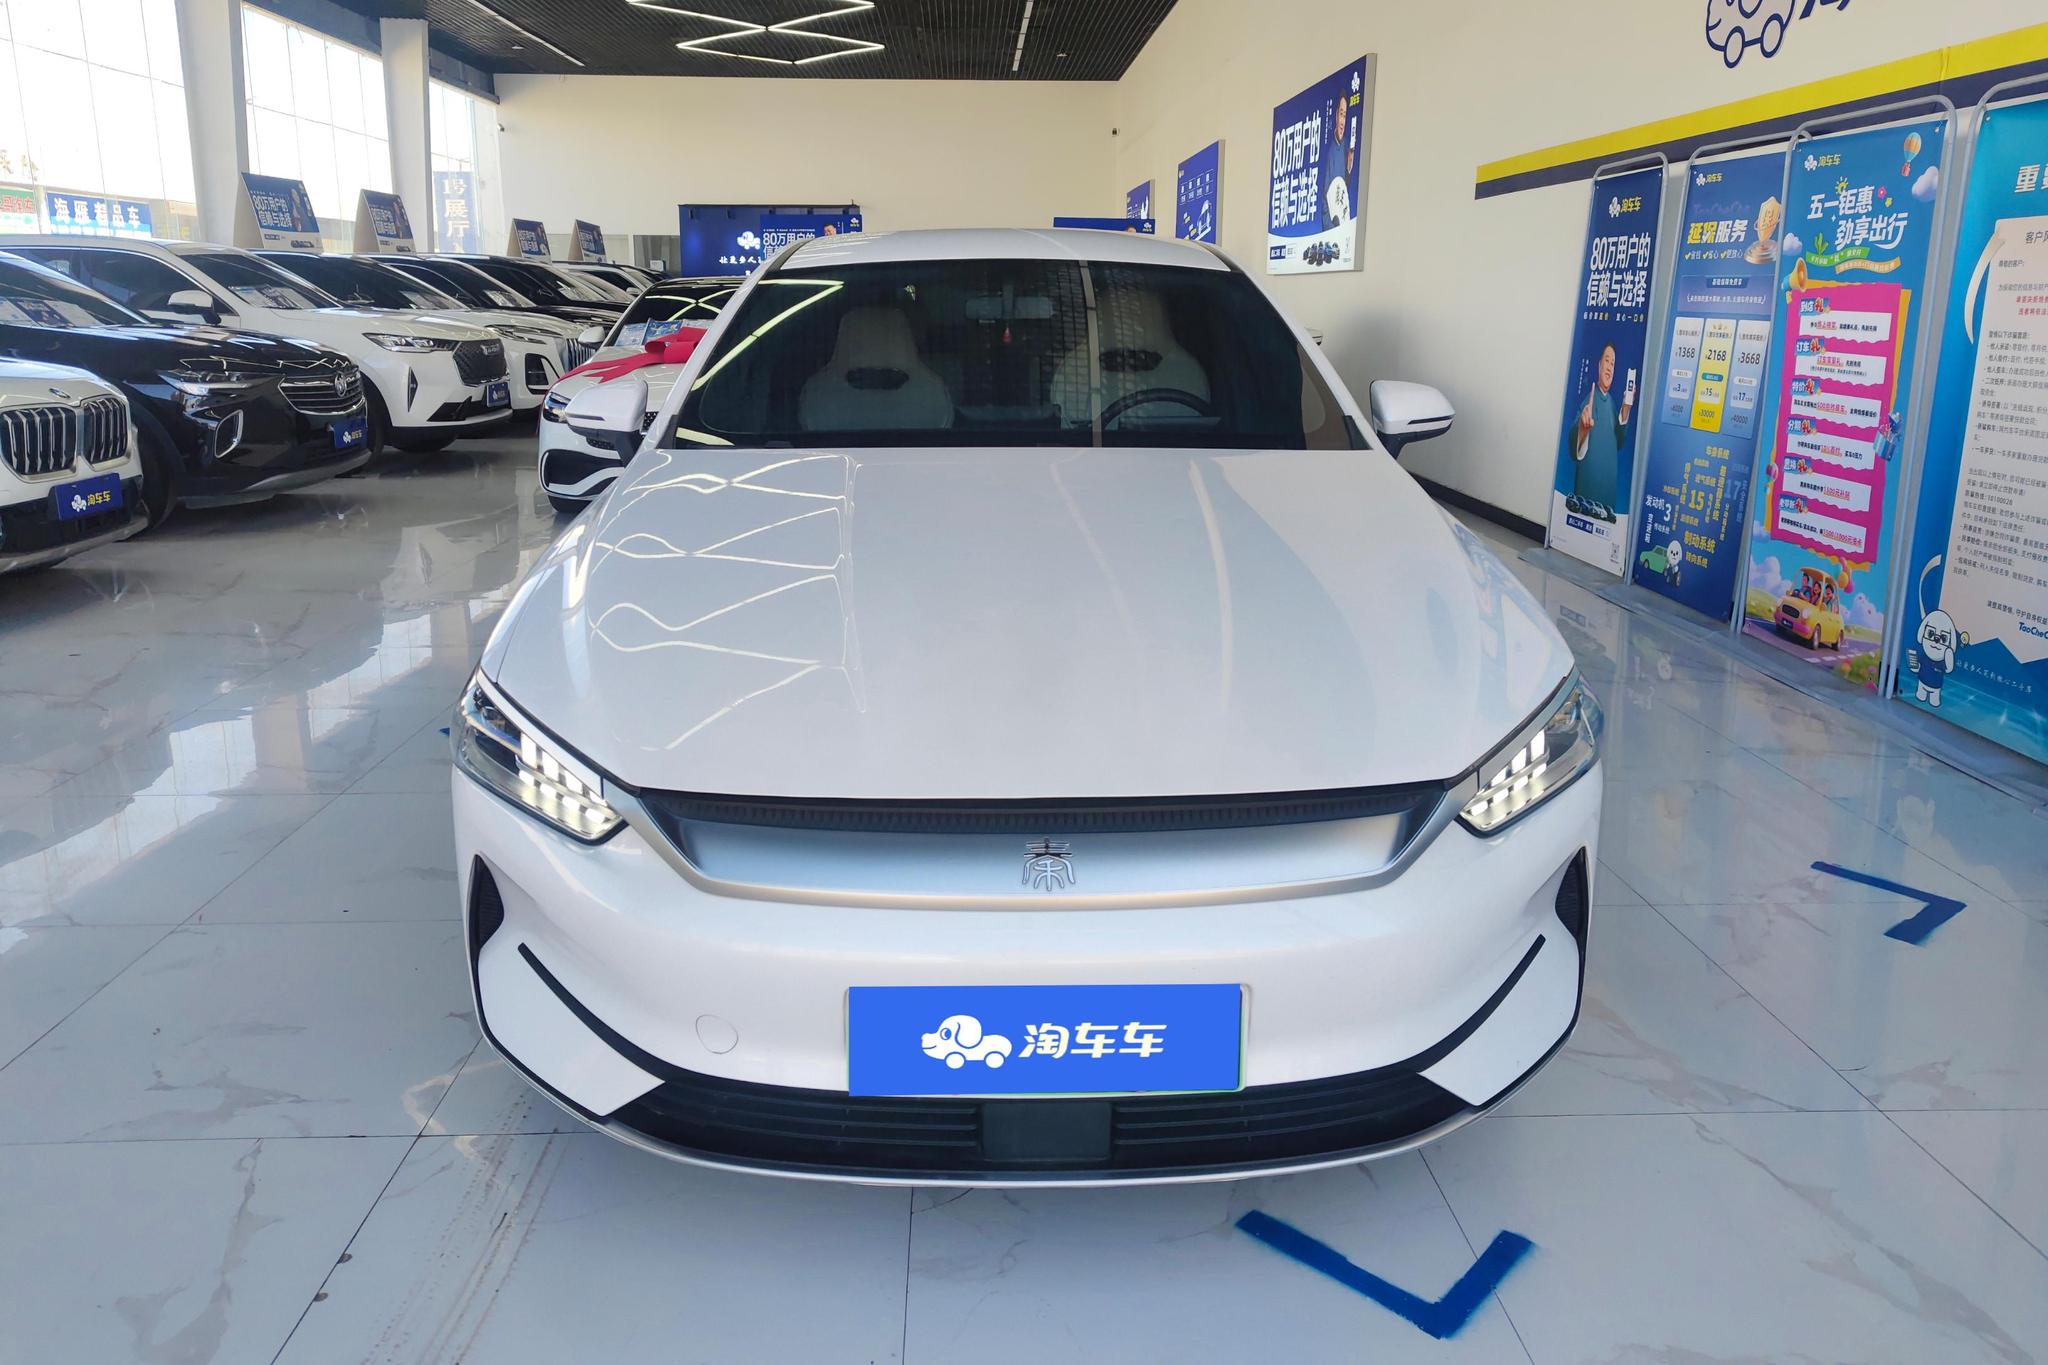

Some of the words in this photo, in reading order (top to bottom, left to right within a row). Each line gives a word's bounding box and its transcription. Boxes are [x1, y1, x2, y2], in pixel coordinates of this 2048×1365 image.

[1273, 110, 1321, 179] 80万用户的
[1818, 154, 1841, 167] 淘车车
[2014, 163, 2048, 194] 重
[1271, 167, 1318, 229] 信赖与选择
[1620, 196, 1642, 213] 淘车车
[1807, 185, 1875, 220] 五一钜惠
[762, 232, 816, 247] 80万用户的
[1687, 219, 1748, 244] 延保服务
[1834, 212, 1909, 251] 劲享出行
[718, 255, 762, 265] 让更多人
[1590, 232, 1651, 271] 80万用户的
[1586, 269, 1647, 308] 信赖与选择
[87, 490, 111, 507] 淘车车
[1645, 494, 1665, 510] 发动机
[1688, 489, 1705, 510] 15
[1663, 503, 1672, 521] 3
[1683, 530, 1716, 555] 制动系统
